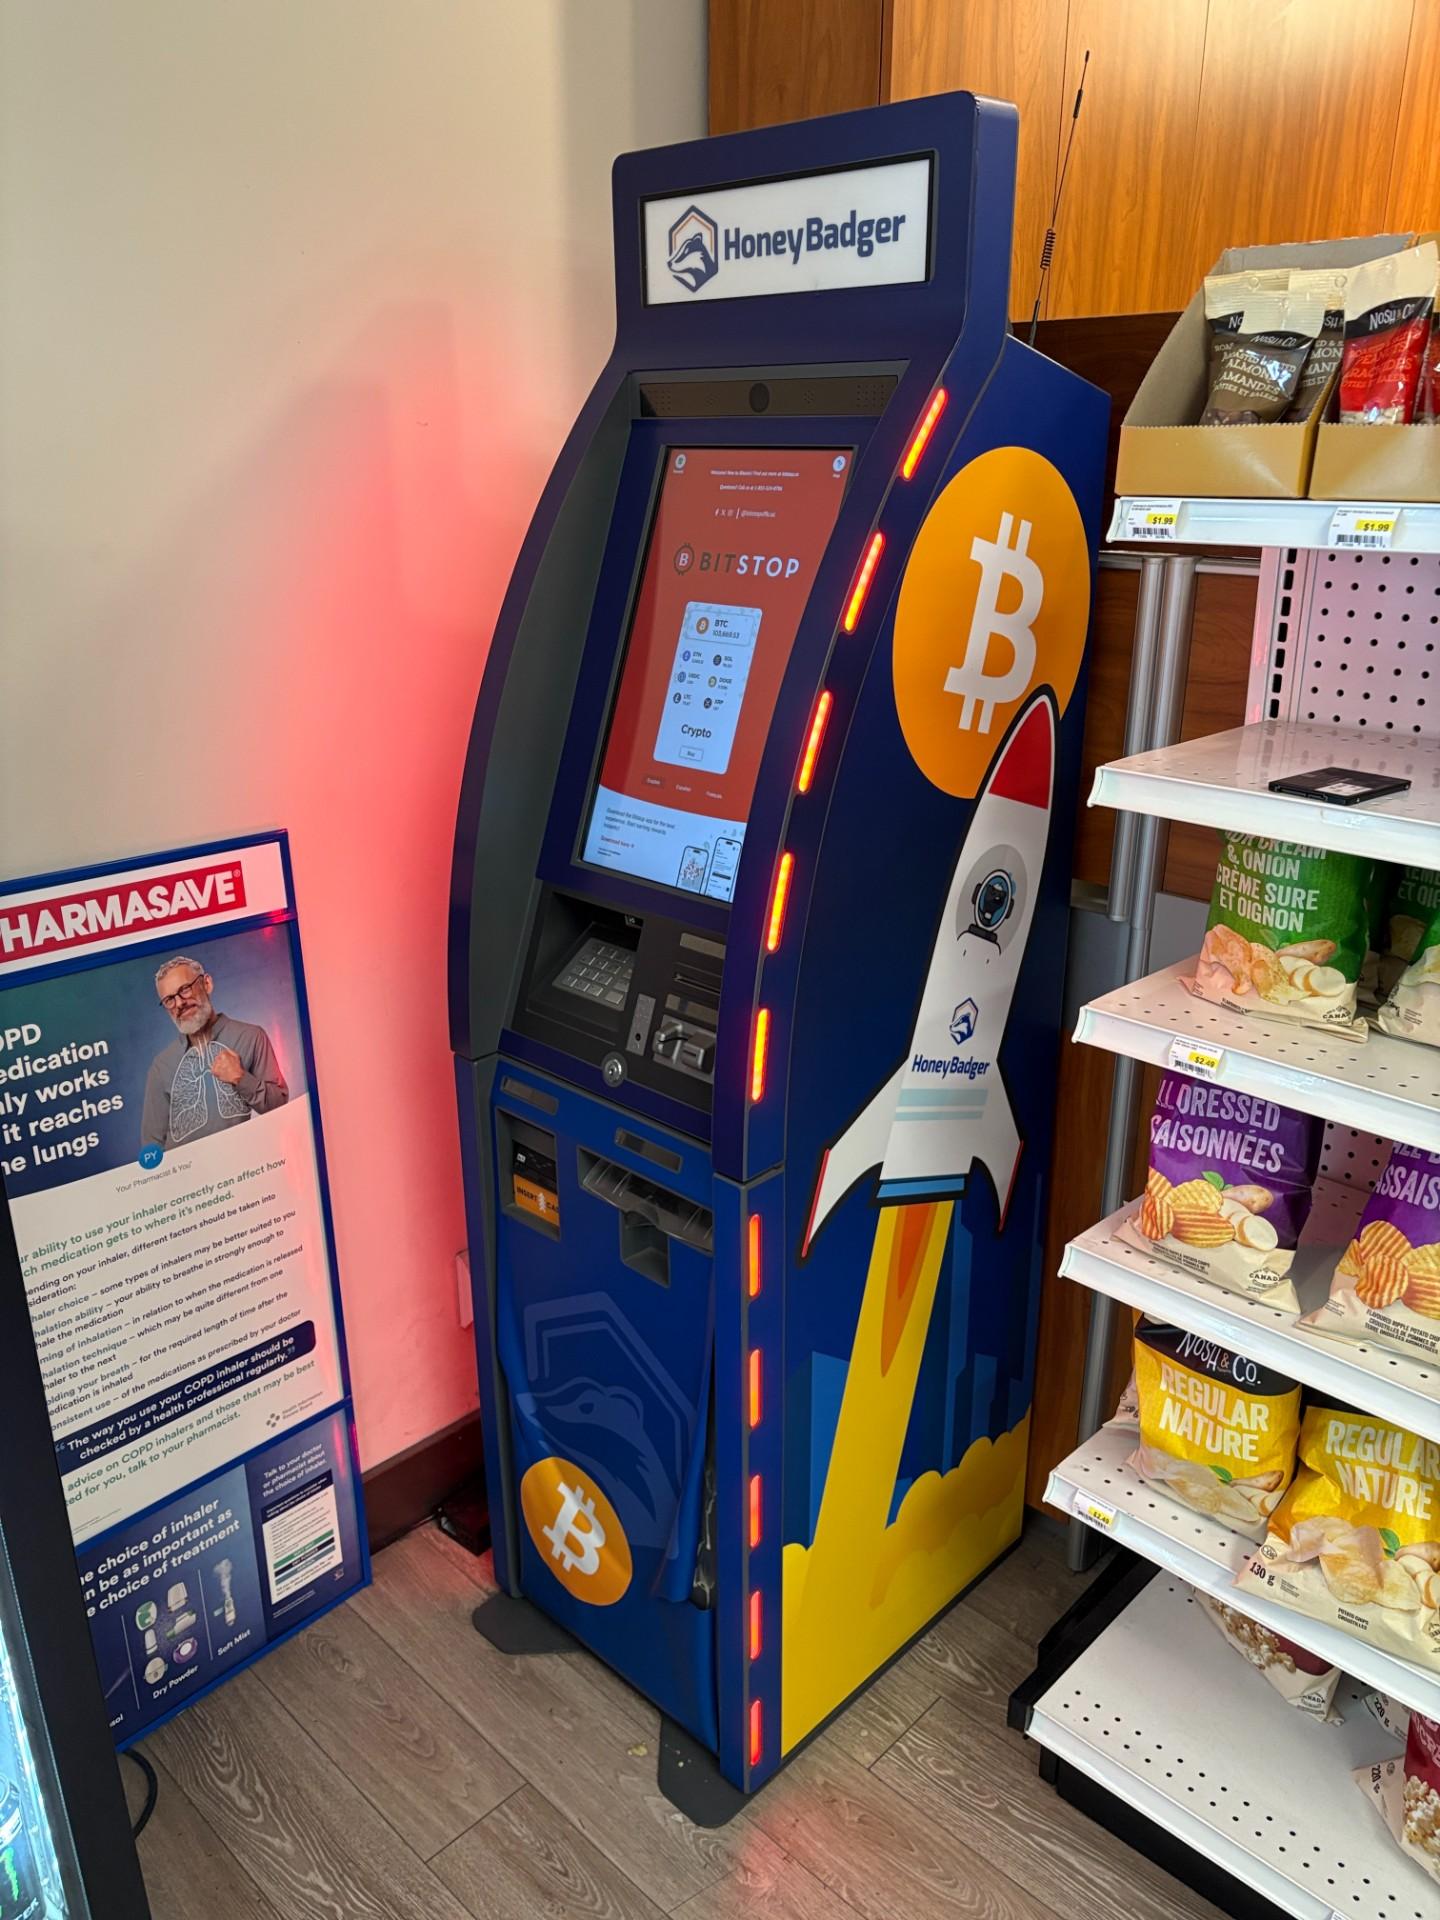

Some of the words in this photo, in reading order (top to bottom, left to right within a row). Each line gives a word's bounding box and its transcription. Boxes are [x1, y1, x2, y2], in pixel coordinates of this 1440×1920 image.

[724, 210, 906, 264] HoneyBadger
[1219, 371, 1281, 395] AMANDES
[1152, 516, 1173, 525] $1.99
[1363, 522, 1390, 532] $1.99
[700, 552, 800, 578] BITSTOP
[714, 619, 729, 628] BTC
[681, 724, 712, 739] Crypto
[1216, 863, 1261, 900] CRÈME
[1264, 882, 1320, 911] SURE
[1227, 844, 1239, 865] &
[1242, 848, 1301, 881] ONION
[0, 870, 236, 952] HARMASAVE
[1220, 887, 1236, 912] ET
[1237, 896, 1305, 934] OIGNON
[35, 1069, 109, 1102] works
[912, 1054, 990, 1080] HoneyBadger
[1, 1123, 21, 1144] it
[29, 1095, 123, 1135] reaches
[1176, 1083, 1281, 1132] DRESSED
[32, 1132, 99, 1165] lungs
[1151, 1114, 1285, 1174] SAISONNÉES
[31, 1240, 67, 1259] ability
[69, 1234, 82, 1244] to
[84, 1226, 103, 1239] use
[105, 1216, 129, 1233] your
[132, 1202, 167, 1220] inhaler
[169, 1184, 214, 1206] correctly
[216, 1177, 234, 1189] can
[236, 1165, 264, 1182] affect
[266, 1158, 285, 1171] how
[40, 1241, 103, 1270] medication
[105, 1231, 128, 1248] gets
[130, 1226, 142, 1235] to
[144, 1213, 176, 1230] where
[194, 1190, 234, 1211] needed.
[61, 1272, 74, 1282] on
[75, 1263, 96, 1278] your
[131, 1234, 168, 1254] different
[168, 1224, 197, 1239] factors
[198, 1211, 225, 1227] should
[226, 1208, 237, 1217] be
[238, 1199, 260, 1212] taken
[261, 1193, 276, 1203] into
[99, 1280, 123, 1295] some
[124, 1270, 148, 1284] types
[149, 1263, 159, 1274] of
[160, 1252, 192, 1269] inhalers
[193, 1245, 210, 1256] may
[211, 1240, 222, 1248] be
[223, 1230, 247, 1244] better
[249, 1218, 272, 1234] suited
[272, 1216, 281, 1224] to
[282, 1210, 296, 1221] you
[91, 1424, 113, 1439] way
[116, 1413, 137, 1430] you
[138, 1403, 157, 1417] use
[158, 1390, 182, 1409] your
[183, 1373, 214, 1394] COPD
[215, 1358, 248, 1378] inhaler
[250, 1341, 280, 1362] should
[281, 1336, 294, 1347] be
[1160, 1362, 1270, 1432] REGULAR
[67, 1468, 103, 1491] advice
[105, 1460, 119, 1472] on
[121, 1441, 153, 1463] COPD
[155, 1422, 194, 1446] inhalers
[195, 1409, 213, 1426] and
[215, 1398, 241, 1415] those
[242, 1387, 261, 1401] that
[262, 1377, 281, 1391] may
[282, 1371, 294, 1381] be
[295, 1359, 314, 1374] best
[79, 1430, 126, 1459] checked
[127, 1424, 141, 1436] by
[144, 1420, 151, 1428] a
[152, 1402, 184, 1423] health
[186, 1371, 244, 1408] professional
[1159, 1396, 1260, 1463] NATURE
[84, 1483, 99, 1496] for
[102, 1472, 126, 1488] you,
[127, 1458, 147, 1474] talk
[148, 1453, 160, 1462] to
[161, 1440, 183, 1458] your
[186, 1411, 240, 1445] pharmacist.
[1335, 1460, 1434, 1520] NATURE
[97, 1540, 148, 1574] choice
[151, 1525, 167, 1544] of
[170, 1499, 218, 1533] inhaler
[98, 1574, 119, 1592] be
[122, 1562, 139, 1578] as
[142, 1518, 214, 1566] important
[217, 1508, 232, 1523] as
[99, 1575, 149, 1609] choice
[152, 1559, 168, 1578] of
[171, 1519, 239, 1566] treatment
[1249, 1562, 1266, 1580] 130
[1267, 1575, 1275, 1587] g
[217, 1641, 233, 1655] Soft
[233, 1629, 250, 1643] Mist
[152, 1685, 167, 1699] Dry
[168, 1665, 198, 1688] Powder
